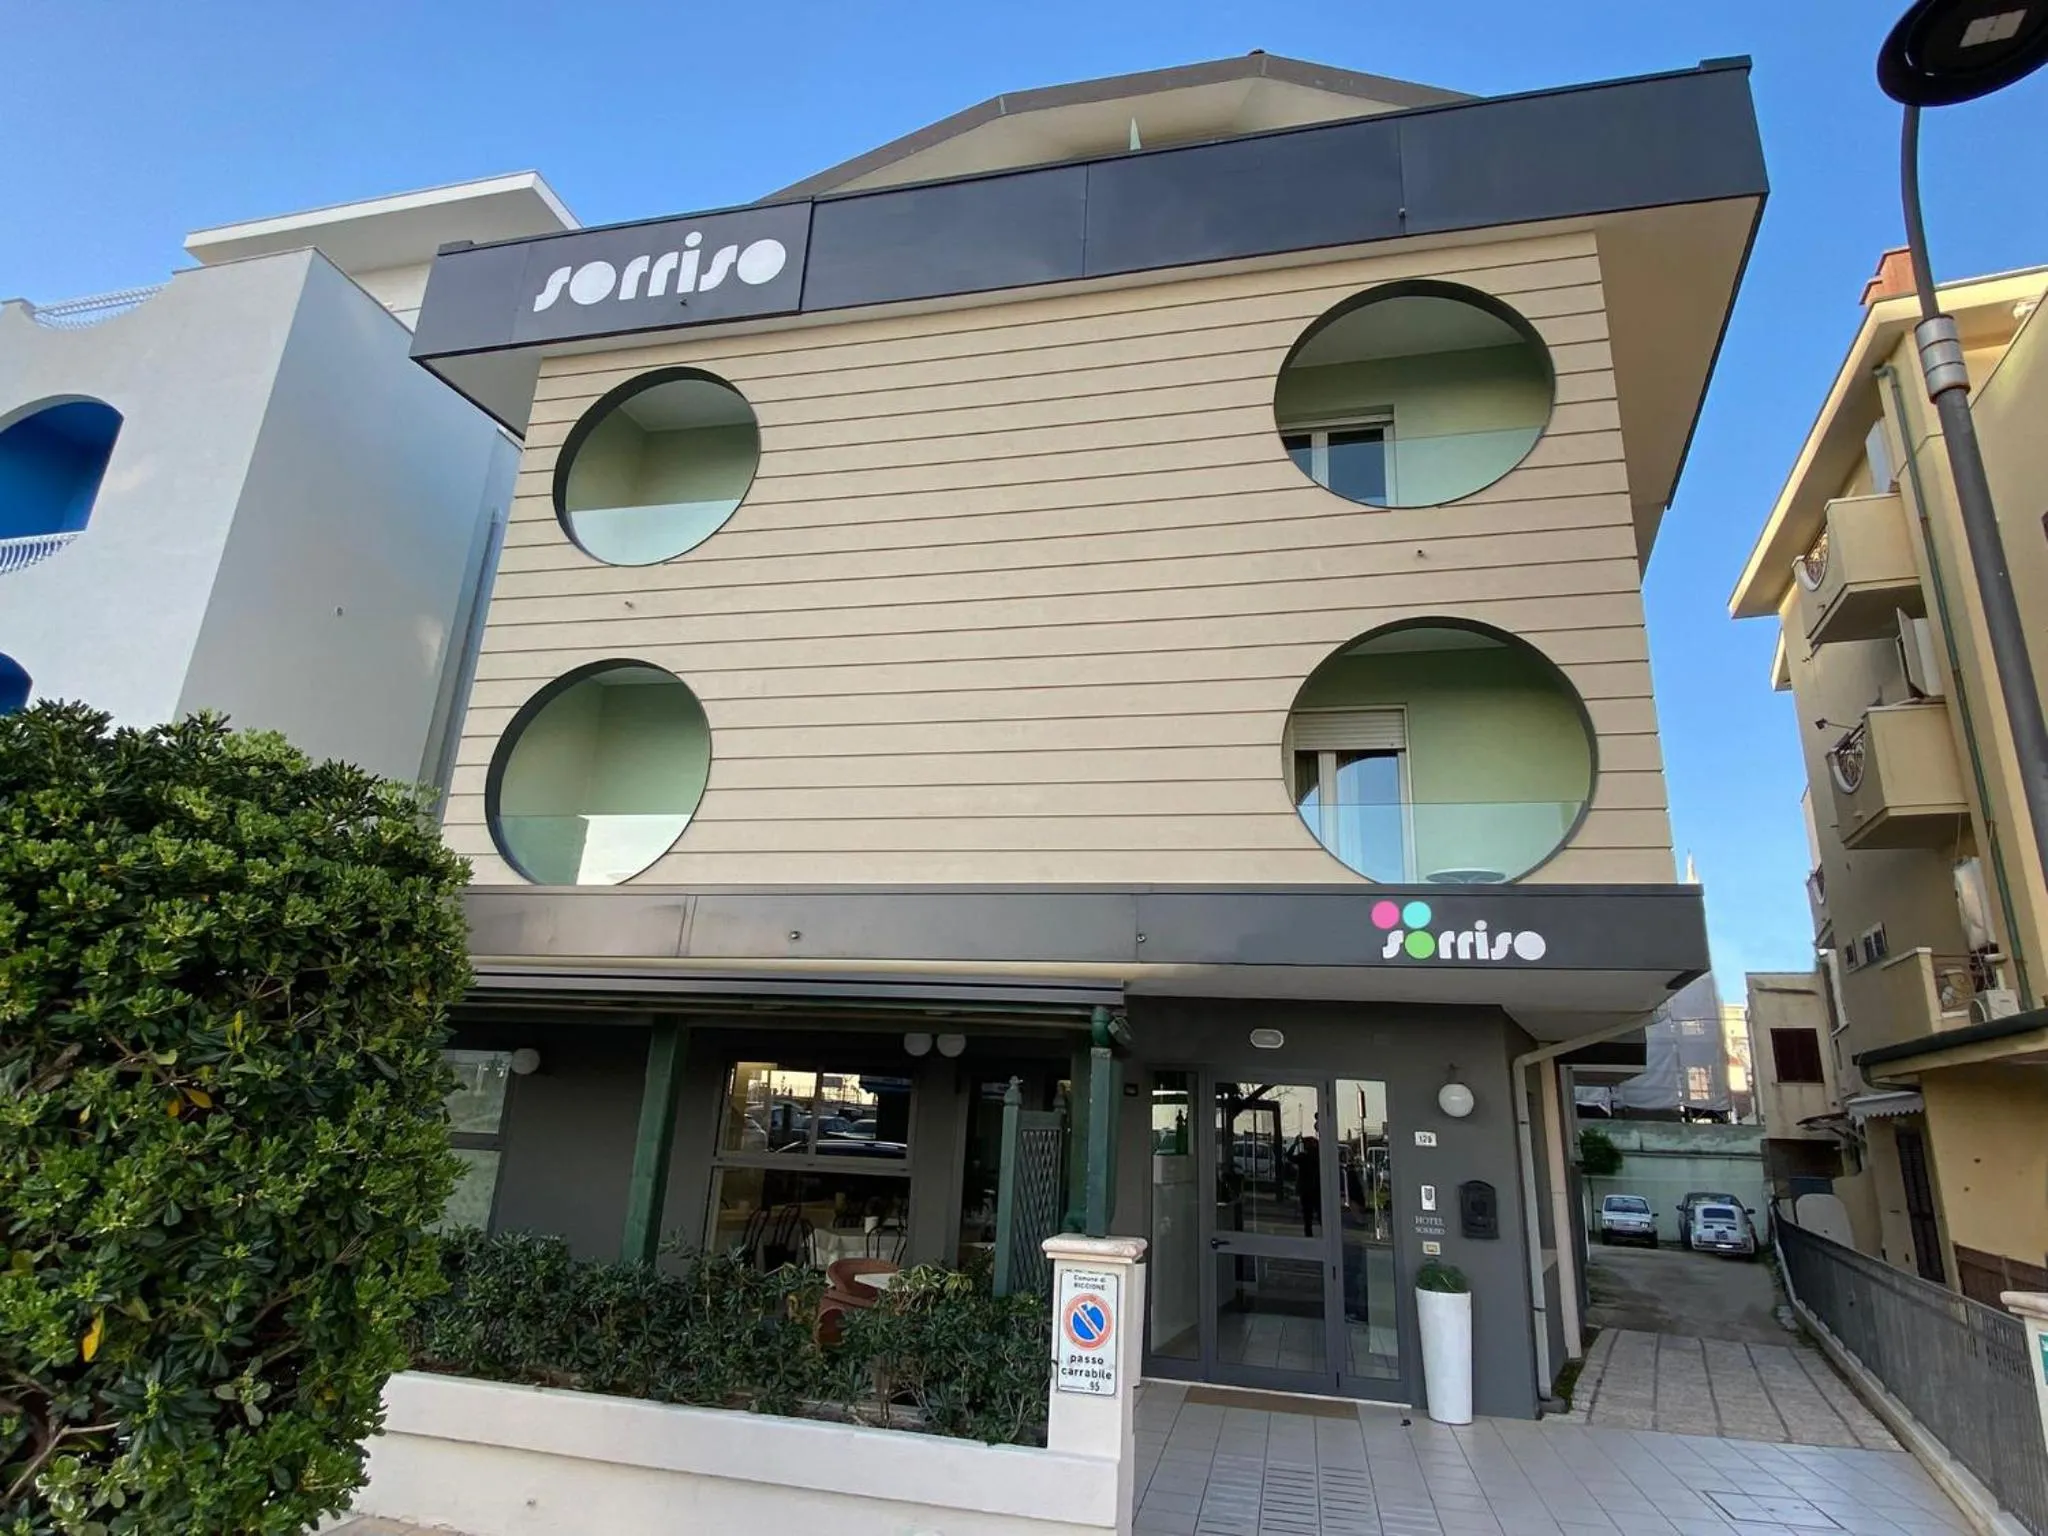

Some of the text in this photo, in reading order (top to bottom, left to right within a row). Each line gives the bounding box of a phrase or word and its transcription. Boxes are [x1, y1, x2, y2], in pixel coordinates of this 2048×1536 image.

[533, 231, 787, 312] sorriso
[1382, 919, 1547, 961] sorriso
[1073, 1274, 1098, 1283] Comune
[1073, 1282, 1106, 1291] RICCIONE
[1070, 1354, 1104, 1366] passo
[1060, 1367, 1112, 1380] carrabile
